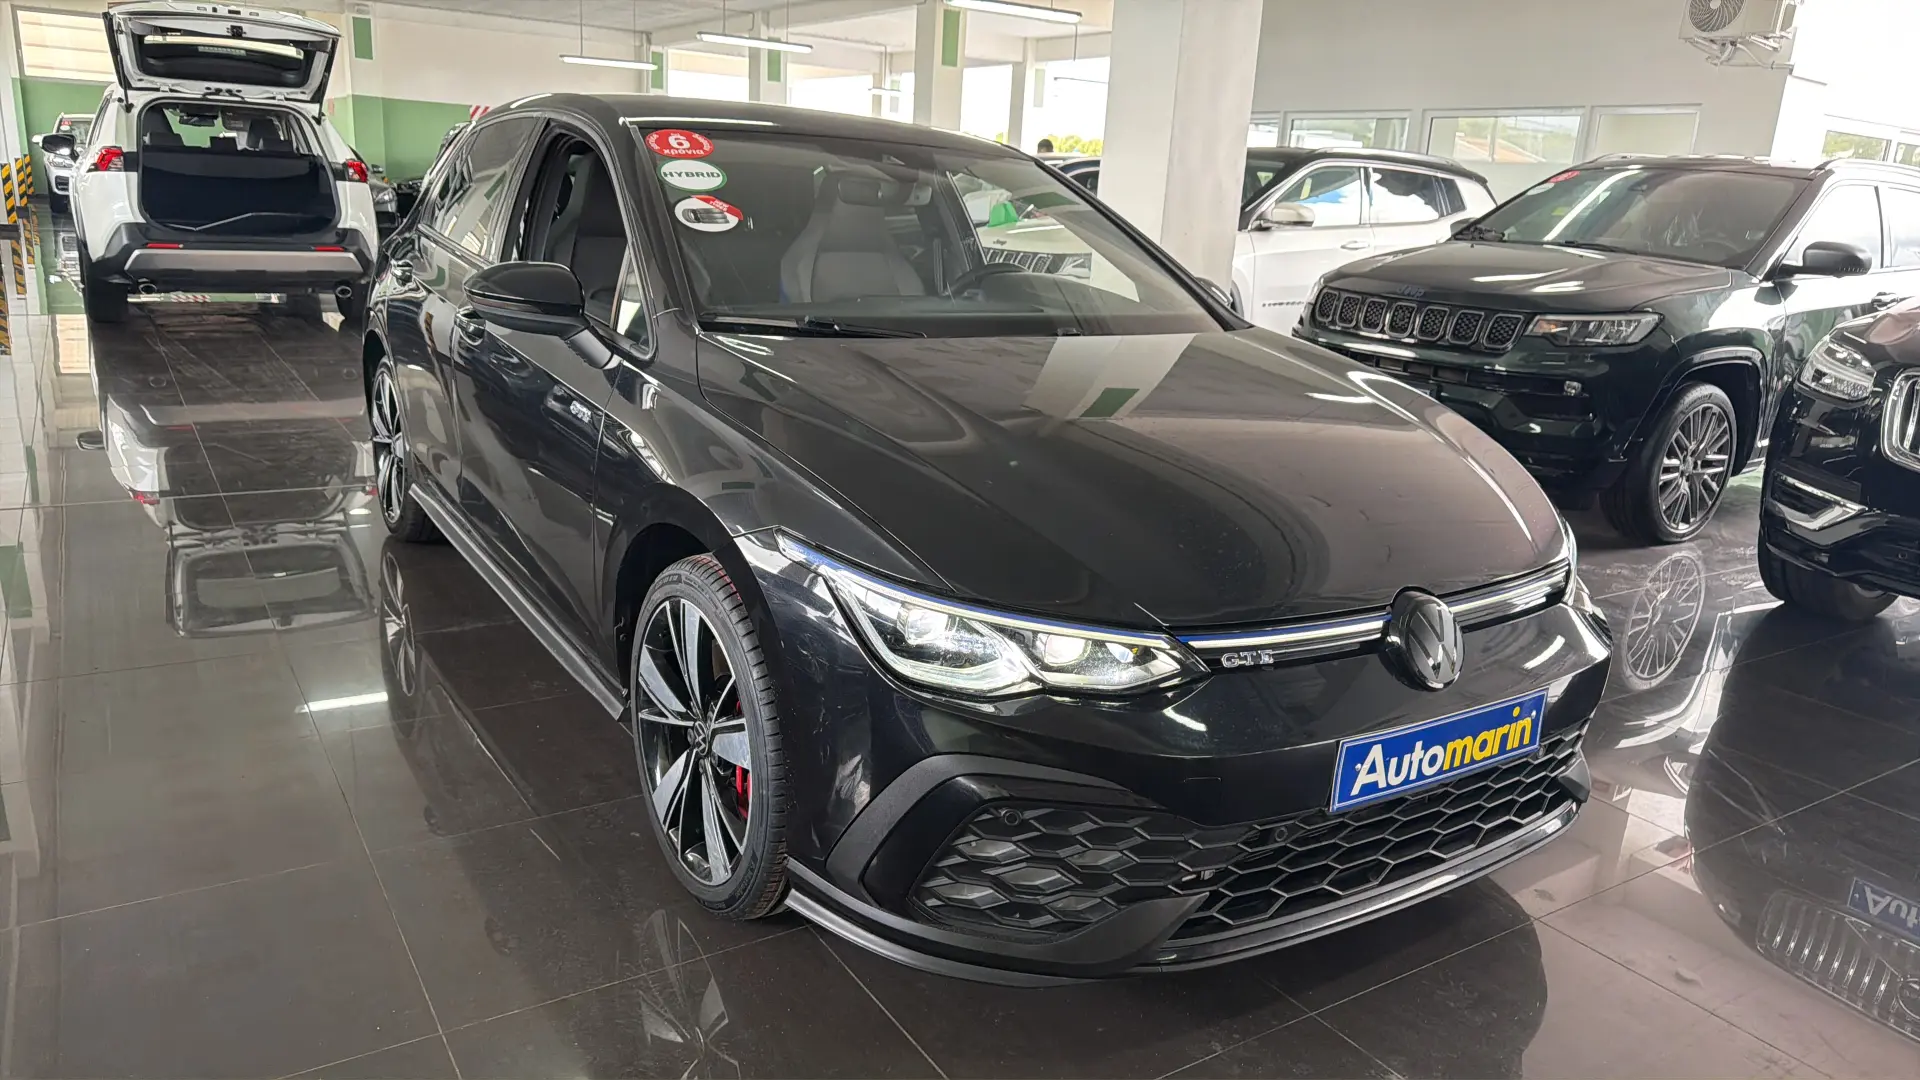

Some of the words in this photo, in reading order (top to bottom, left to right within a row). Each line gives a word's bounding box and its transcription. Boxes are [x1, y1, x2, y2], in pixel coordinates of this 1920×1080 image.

[668, 135, 691, 149] 6
[1221, 650, 1274, 668] GTE
[1350, 706, 1533, 796] Automarin
